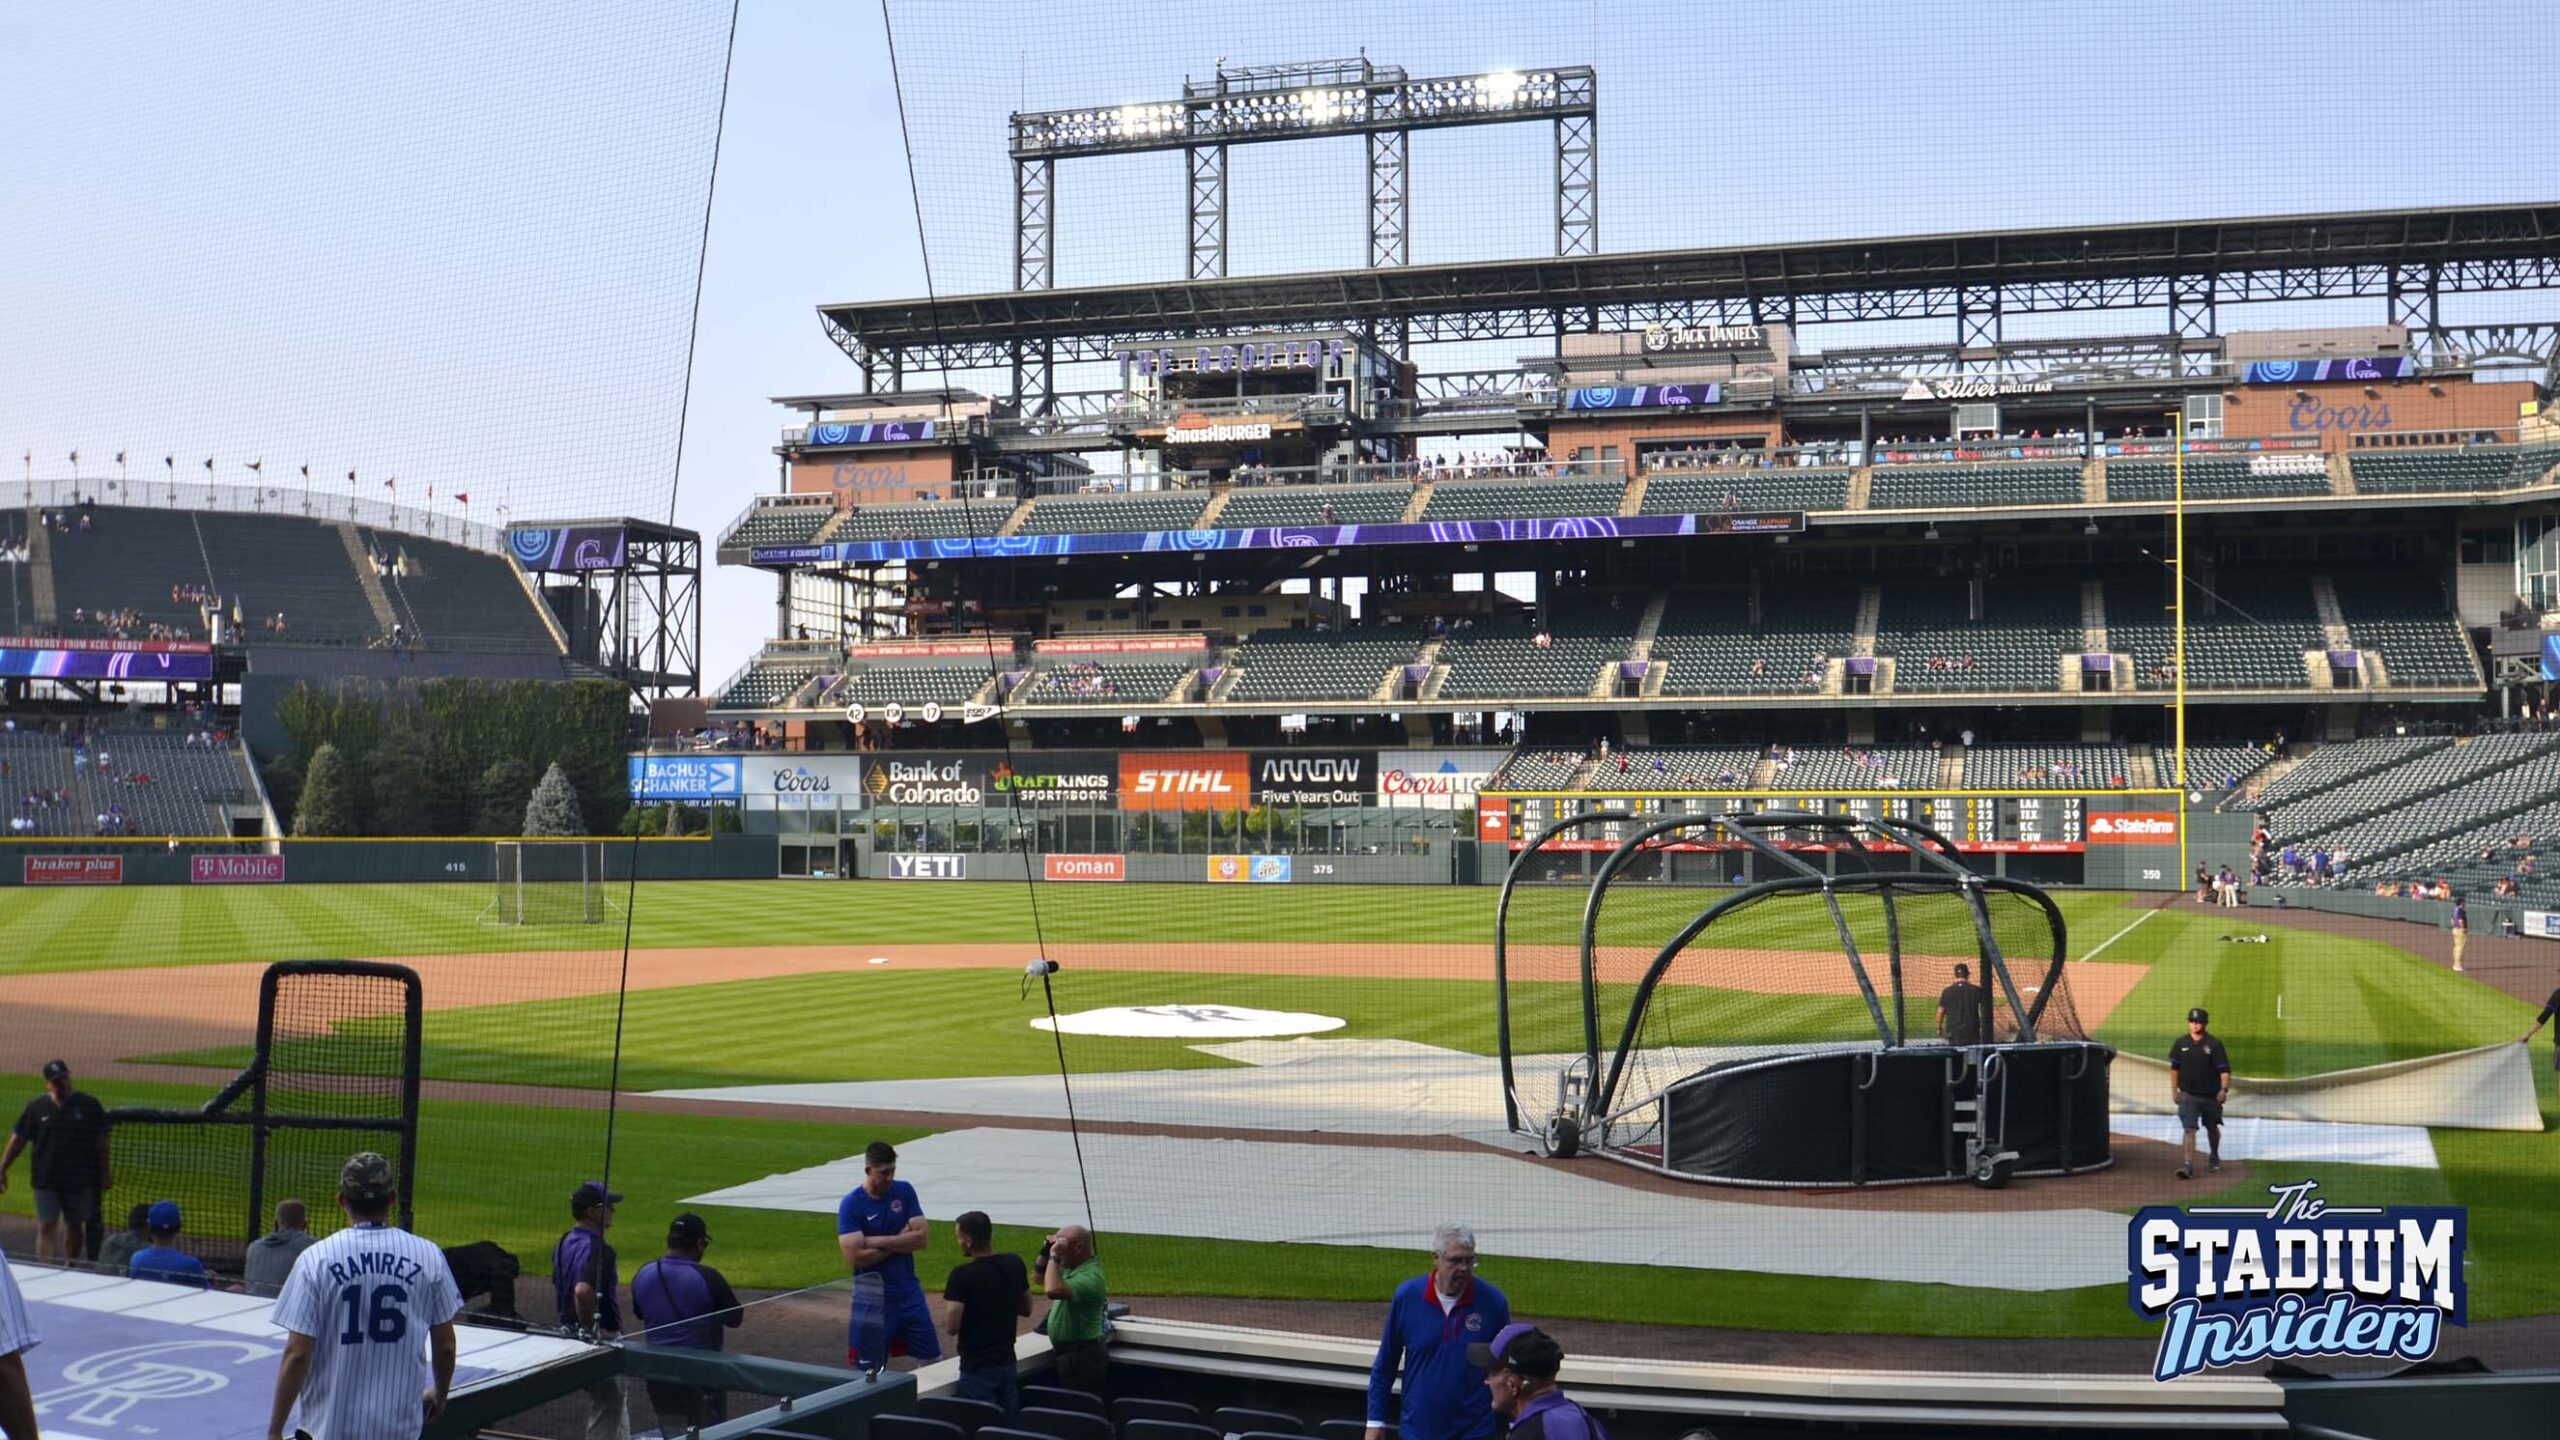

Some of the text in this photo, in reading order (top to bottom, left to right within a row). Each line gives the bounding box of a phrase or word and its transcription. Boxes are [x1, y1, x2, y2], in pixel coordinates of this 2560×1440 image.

[1672, 328, 1706, 344] JACK
[1117, 339, 1344, 377] THE ROOFTOP
[1937, 380, 1998, 399] Silver
[2001, 384, 2032, 393] BULLET
[2034, 383, 2052, 391] BAR
[2288, 396, 2392, 432] Coors
[2220, 442, 2246, 450] LIGHT
[2291, 440, 2318, 448] LIGHT
[832, 458, 906, 488] Coors
[29, 638, 60, 649] ENERGY
[64, 639, 87, 650] FROM
[90, 640, 109, 650] XCEL
[112, 640, 143, 651] ENERGY
[849, 710, 860, 719] 42
[926, 707, 937, 717] 17
[649, 763, 707, 778] BACHUS
[890, 760, 963, 782] Bank of
[1262, 759, 1360, 782] ARROW
[774, 768, 830, 792] Coors
[1135, 769, 1232, 792] STIHL
[1383, 769, 1449, 794] Coors
[631, 778, 707, 793] SCHANKER
[890, 781, 980, 804] Colorado
[1021, 790, 1107, 800] SPORTSBOOK
[1262, 789, 1359, 803] Five Years Out
[1526, 799, 1540, 809] PIT
[1604, 799, 1624, 809] NYM
[1685, 799, 1741, 809] SF 34
[1767, 799, 1779, 809] SD
[1850, 799, 1868, 809] SEA
[1935, 799, 1951, 809] CLE
[1977, 799, 1993, 809] 36
[2020, 799, 2080, 809] LAA 17
[1524, 810, 1540, 819] MIL
[1935, 810, 1953, 820] TOR
[1977, 810, 1993, 820] 22
[2020, 810, 2080, 820] TEX 39
[1605, 821, 1620, 831] ATL
[1934, 821, 1953, 831] BOS
[1977, 821, 1993, 831] 57
[2020, 821, 2080, 831] KC 43
[1605, 831, 1619, 841] STL
[1978, 832, 1993, 842] 12
[2021, 832, 2080, 842] CHW 27
[32, 858, 115, 872] brakes plus
[218, 859, 278, 876] Mobile
[445, 862, 466, 872] 415
[896, 857, 959, 877] YETI
[1056, 862, 1114, 875] roman
[1313, 864, 1333, 874] 375
[2142, 869, 2160, 879] 350
[329, 1252, 422, 1286] RAMIREZ
[341, 1284, 408, 1345] 16
